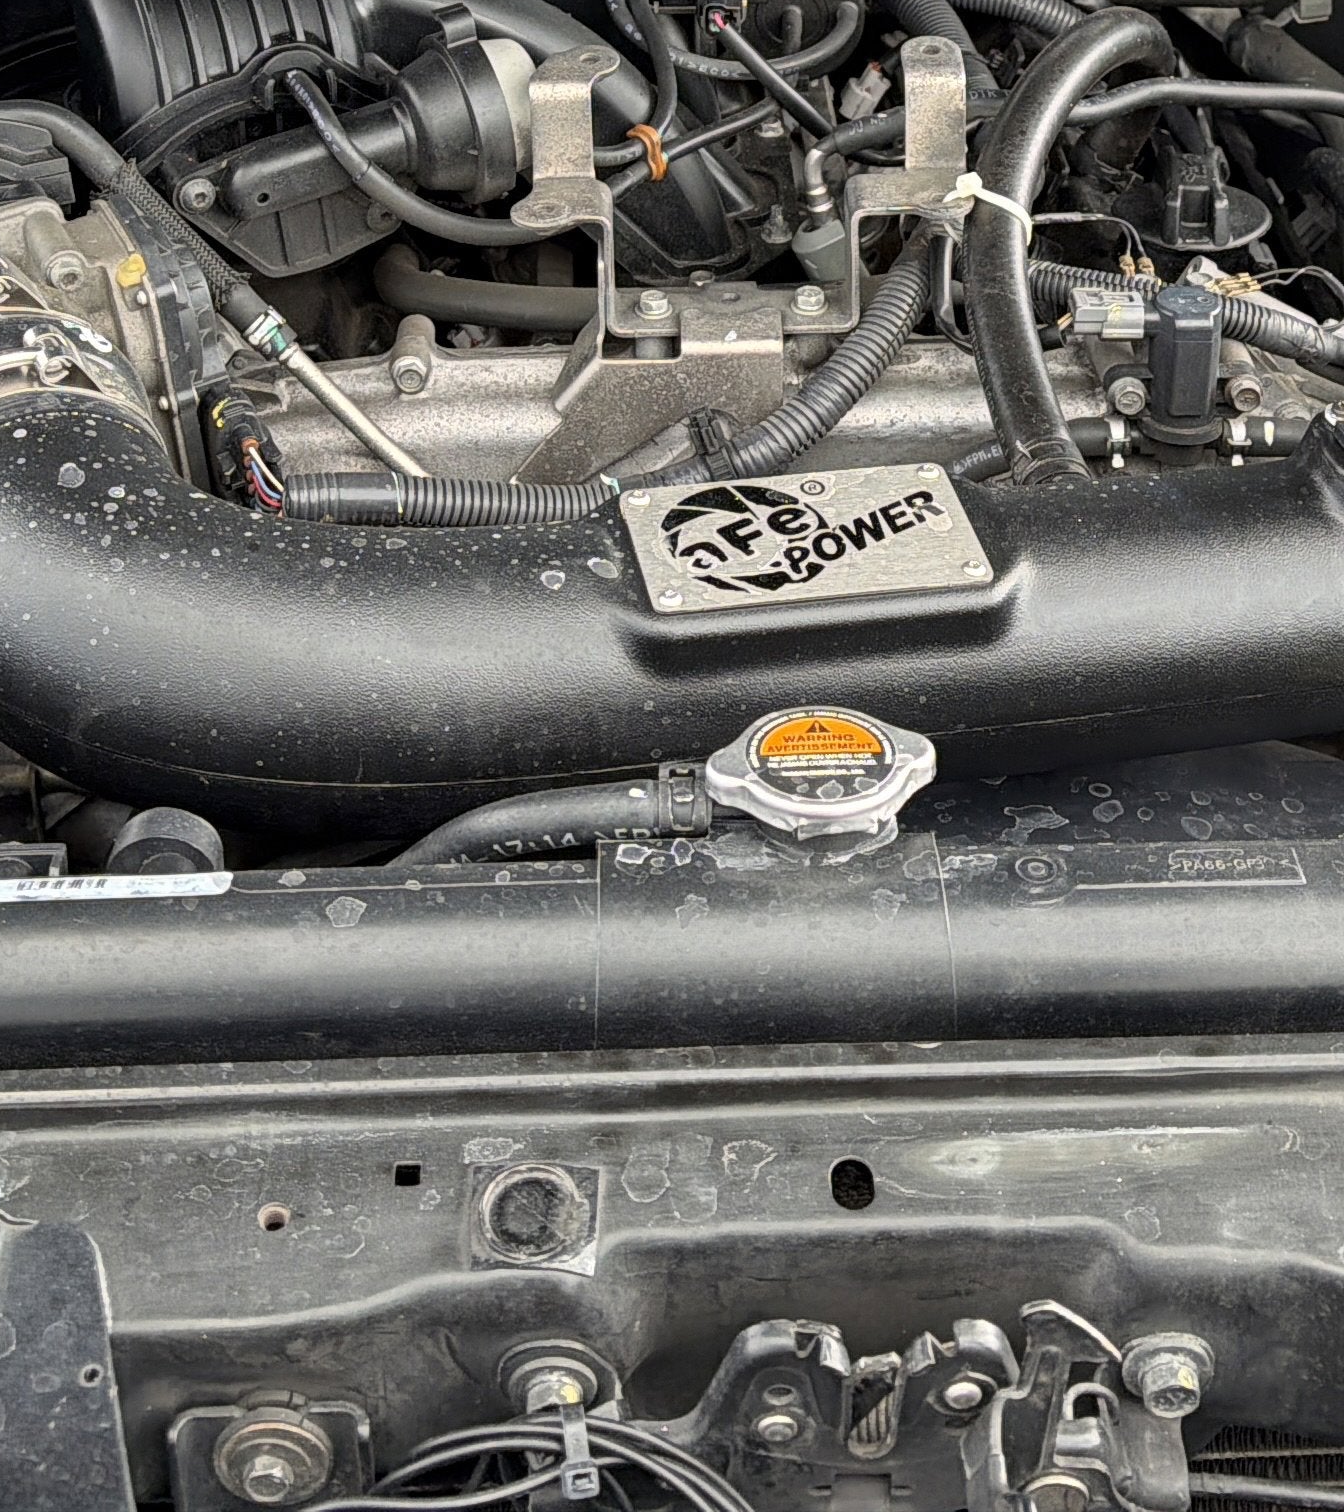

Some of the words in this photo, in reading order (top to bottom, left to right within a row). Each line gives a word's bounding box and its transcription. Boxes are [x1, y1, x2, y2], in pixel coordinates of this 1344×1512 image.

[782, 490, 945, 575] POWER
[782, 735, 856, 743] WARNING
[767, 743, 874, 752] AVERTISSEMENT
